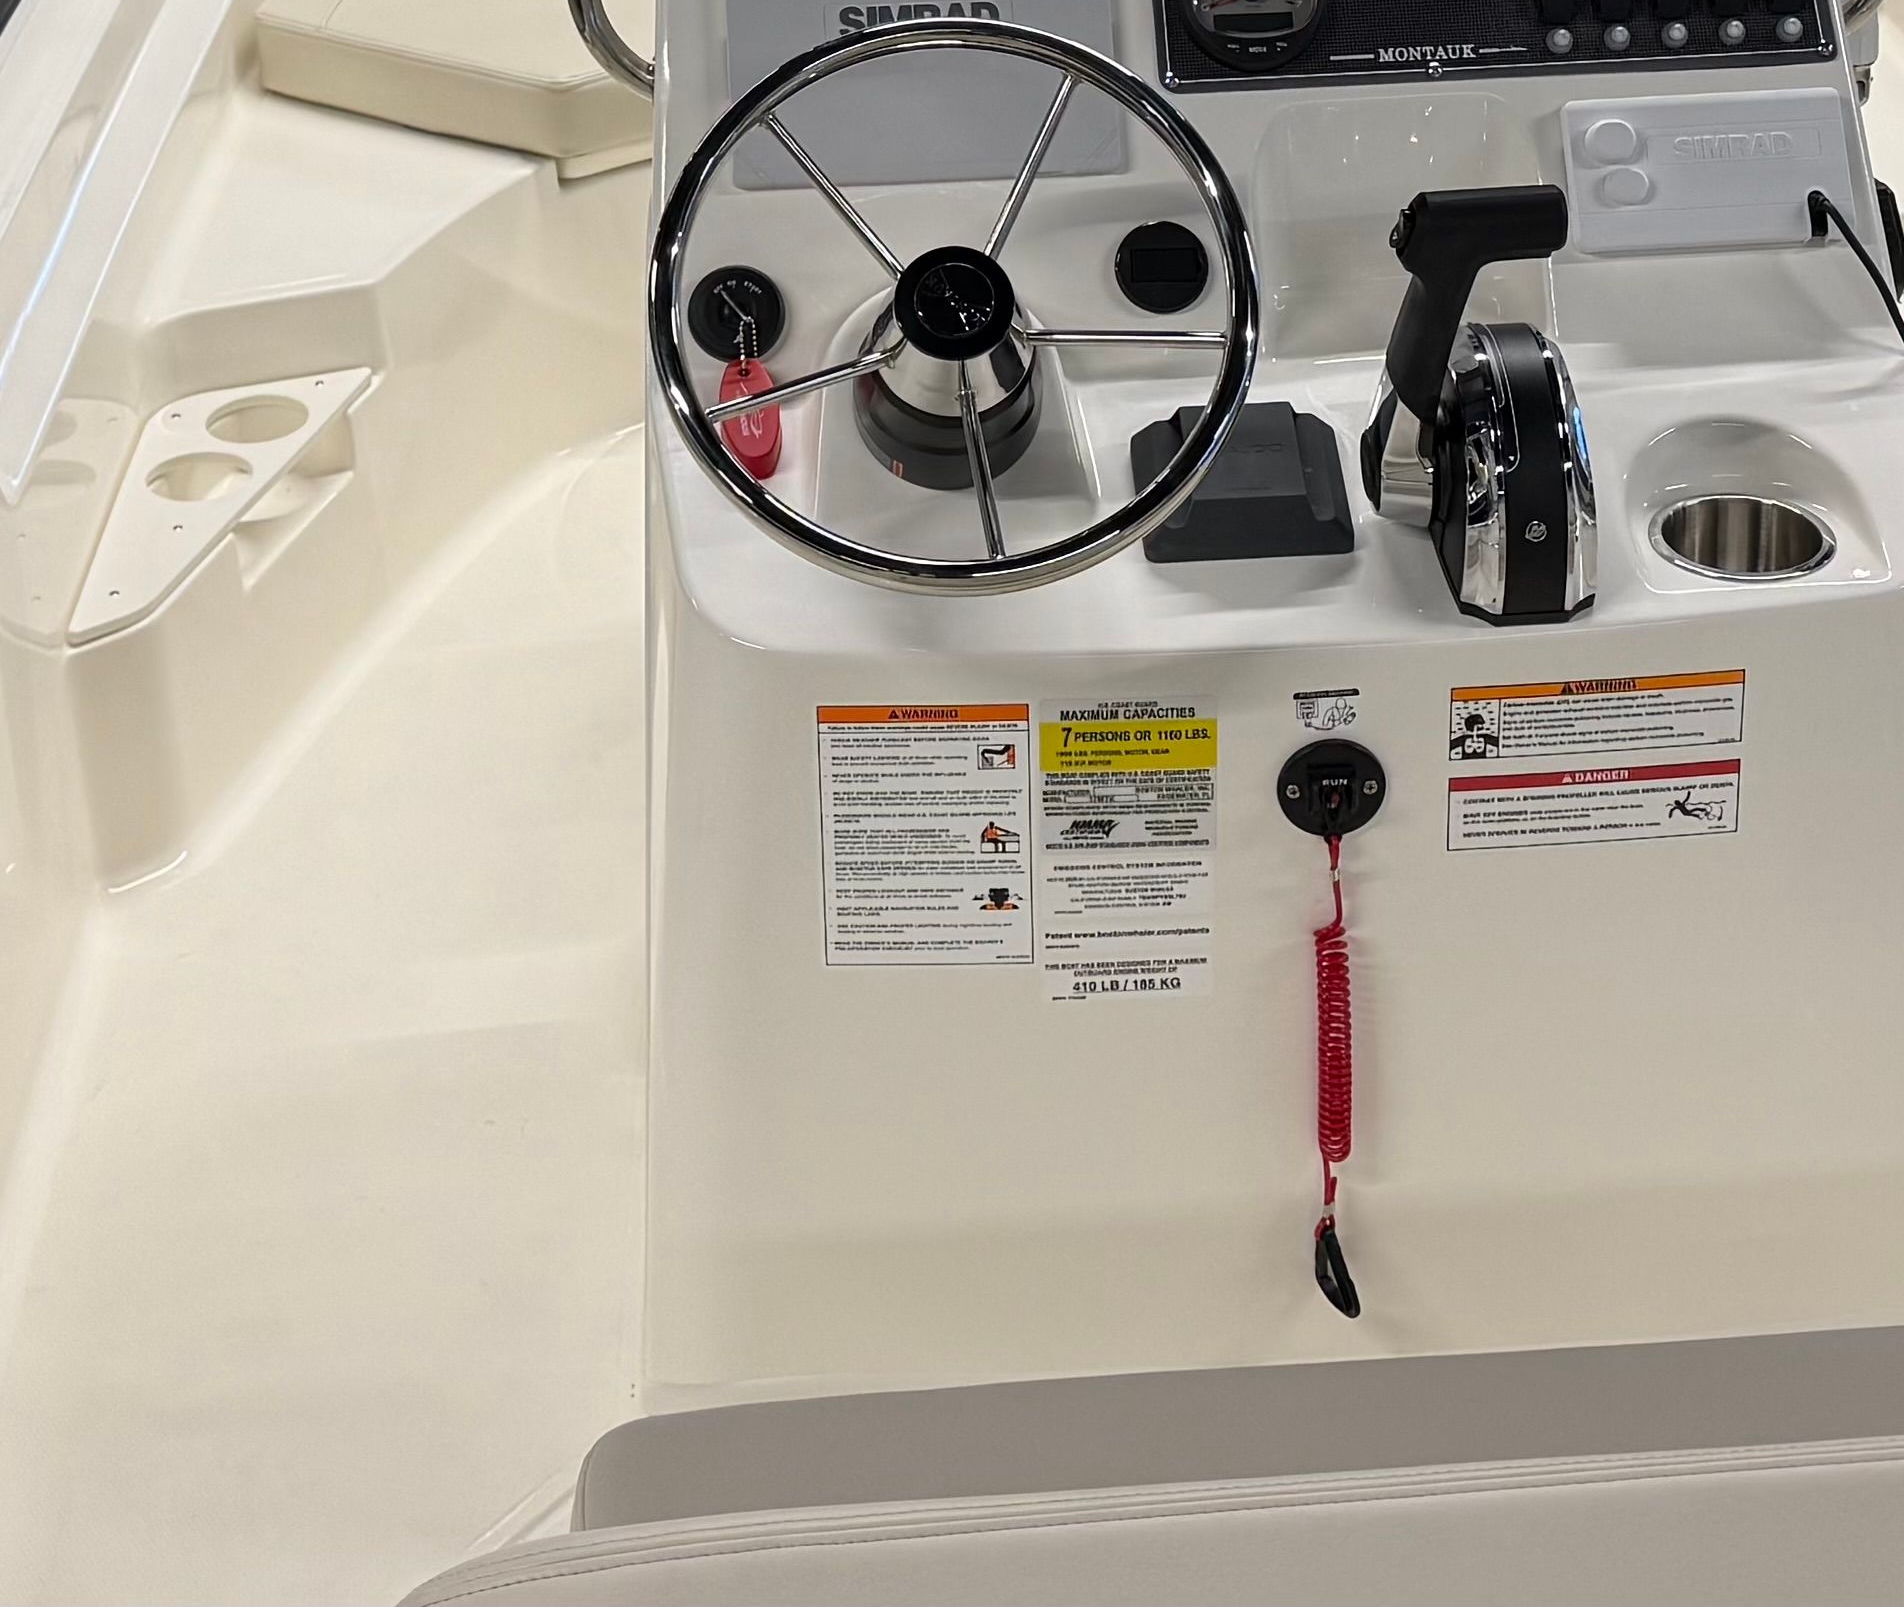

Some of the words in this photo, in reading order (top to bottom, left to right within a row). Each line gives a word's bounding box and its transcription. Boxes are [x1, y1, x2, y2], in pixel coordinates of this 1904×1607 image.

[1378, 44, 1477, 63] MONTAUK
[1673, 131, 1793, 160] SIMRAD
[1060, 709, 1119, 721] MAXIMUM
[1123, 707, 1196, 720] CAPACITIES
[1061, 727, 1072, 748] 7
[1074, 731, 1131, 743] PERSONS
[1134, 730, 1152, 741] OR
[1185, 728, 1211, 740] LBS.
[1574, 770, 1630, 783] DANGER
[1073, 981, 1097, 993] 410
[1101, 980, 1120, 992] LB
[1160, 977, 1182, 990] KG
